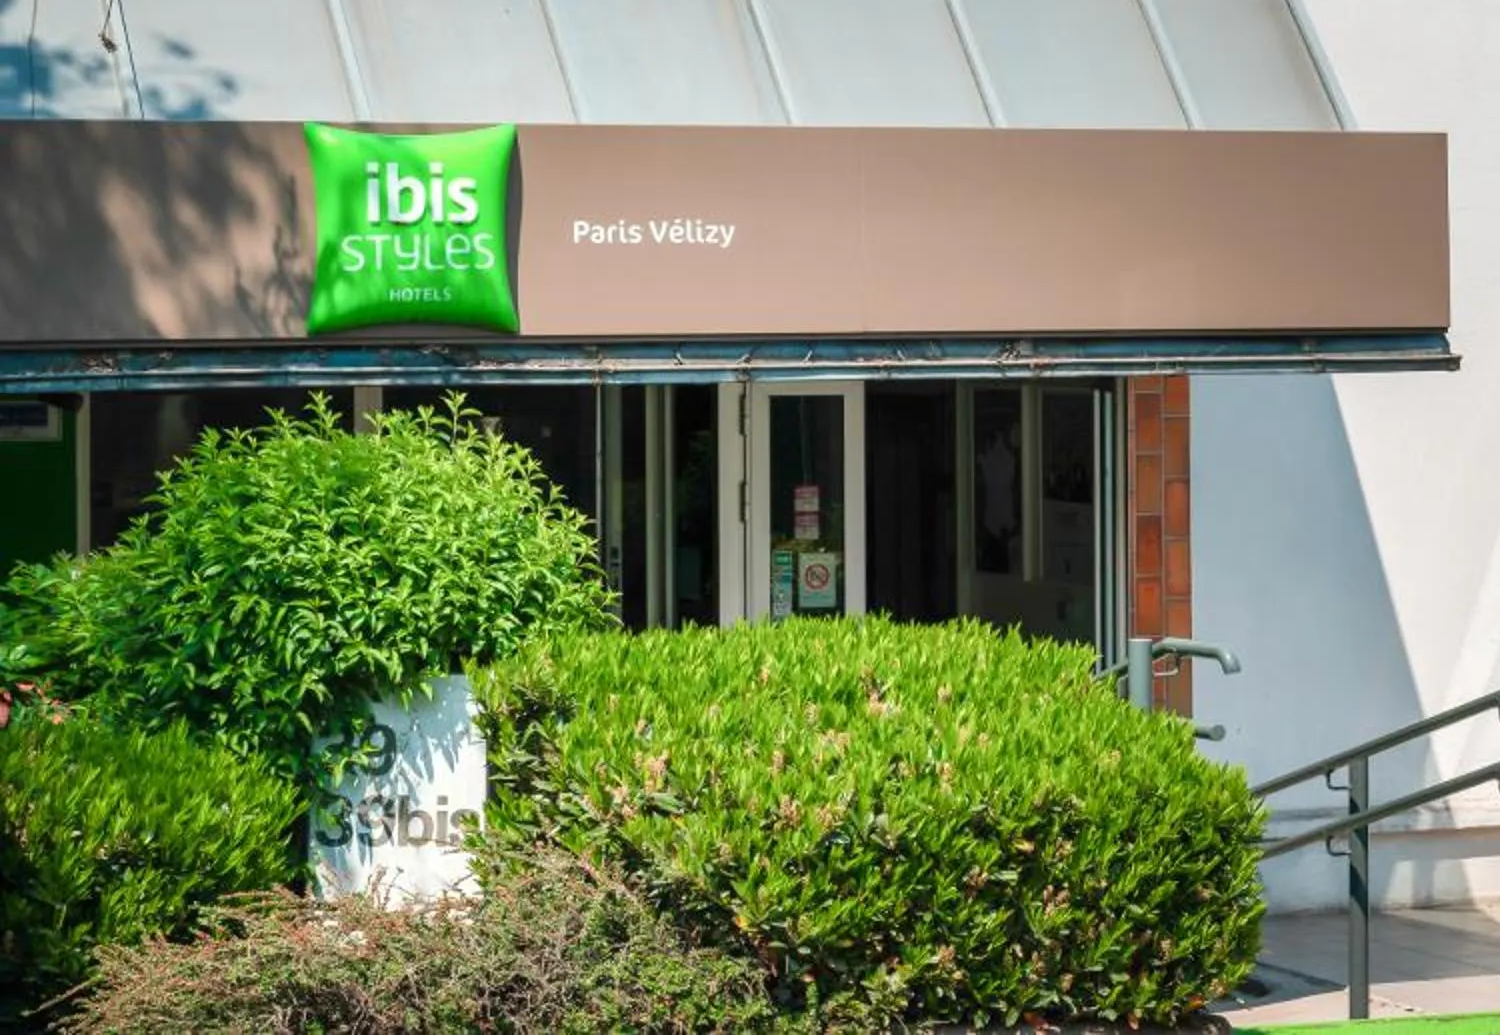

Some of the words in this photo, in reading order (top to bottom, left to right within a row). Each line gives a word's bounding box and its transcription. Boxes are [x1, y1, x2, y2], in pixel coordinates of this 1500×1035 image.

[365, 160, 479, 224] ibis
[573, 220, 642, 246] Paris
[649, 218, 736, 249] Vélizy
[388, 286, 453, 302] HOTELS
